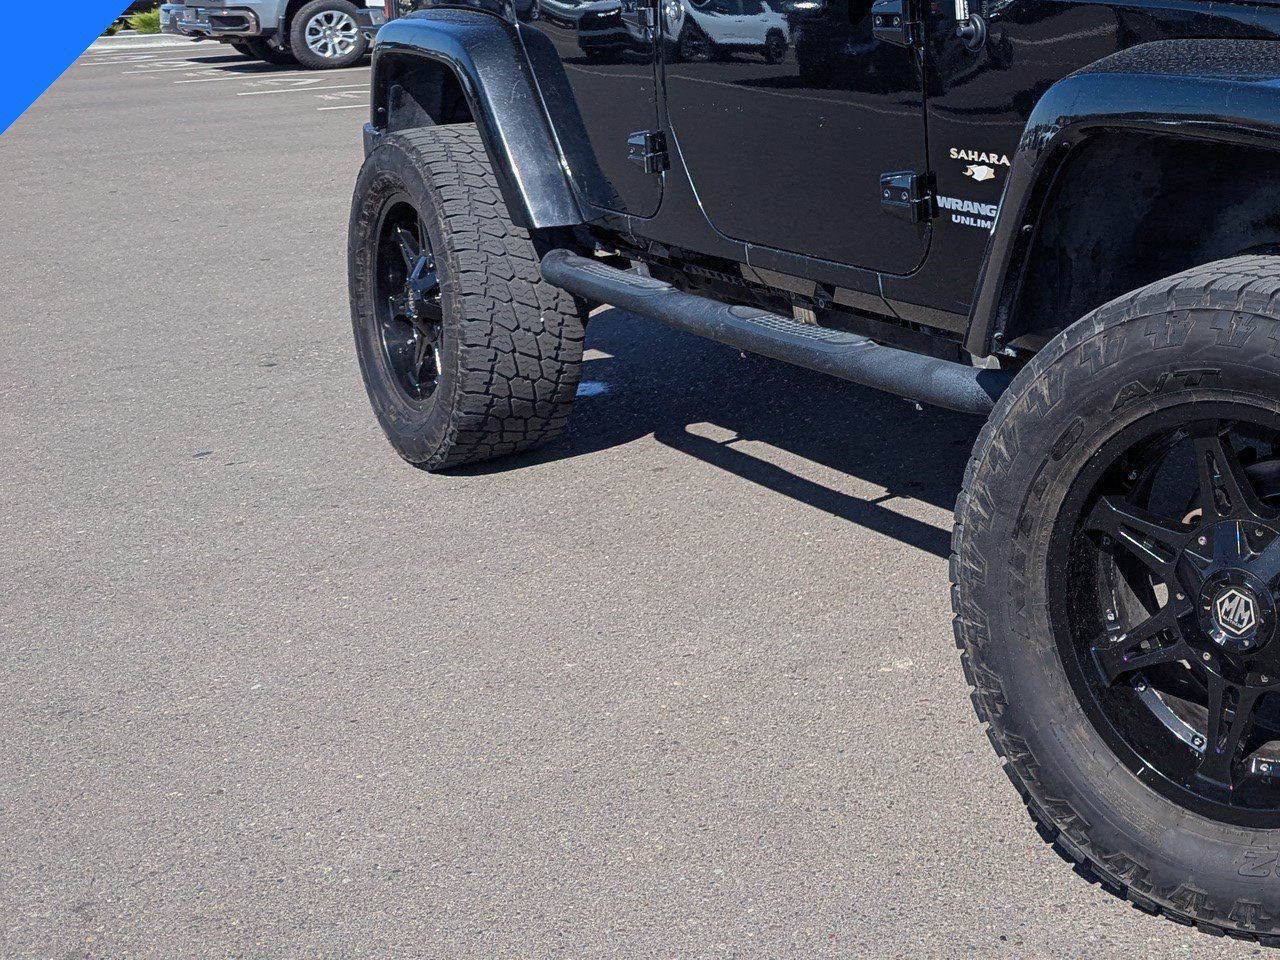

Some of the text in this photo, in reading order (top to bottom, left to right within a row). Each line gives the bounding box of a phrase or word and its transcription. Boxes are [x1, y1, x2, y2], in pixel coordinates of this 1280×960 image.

[949, 147, 1011, 166] SAHARA
[936, 195, 998, 217] WRANG
[951, 214, 993, 229] UNLIM
